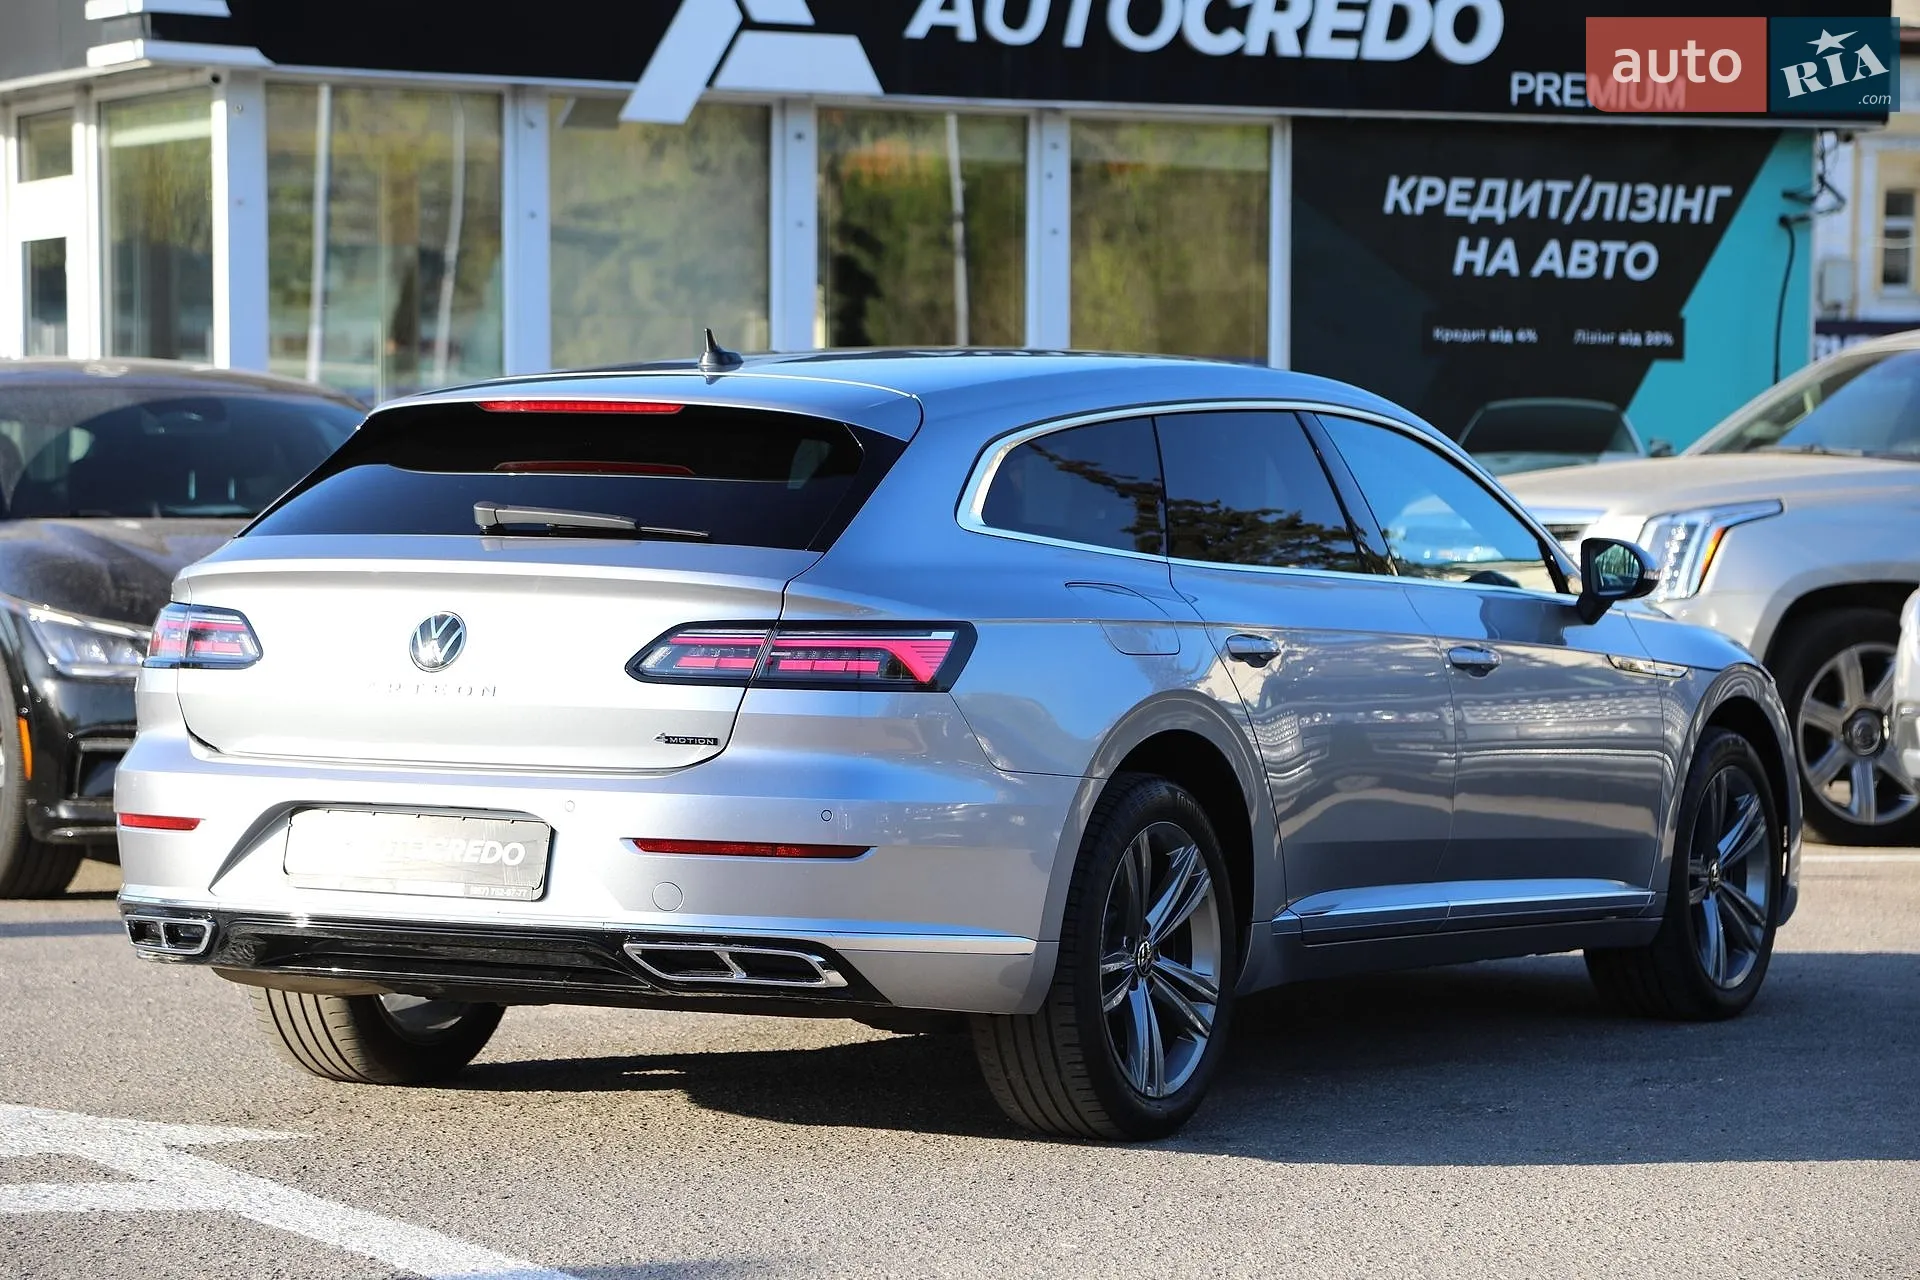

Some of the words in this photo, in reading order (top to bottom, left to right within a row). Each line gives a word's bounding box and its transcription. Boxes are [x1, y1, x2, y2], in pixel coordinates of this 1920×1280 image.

[1510, 71, 1687, 111] PREMIUM
[1383, 174, 1733, 225] КРЕДИТ/ЛІЗІНГ
[1453, 236, 1521, 277] НА
[1529, 238, 1660, 281] АВТО
[654, 731, 715, 746] 4MOTION
